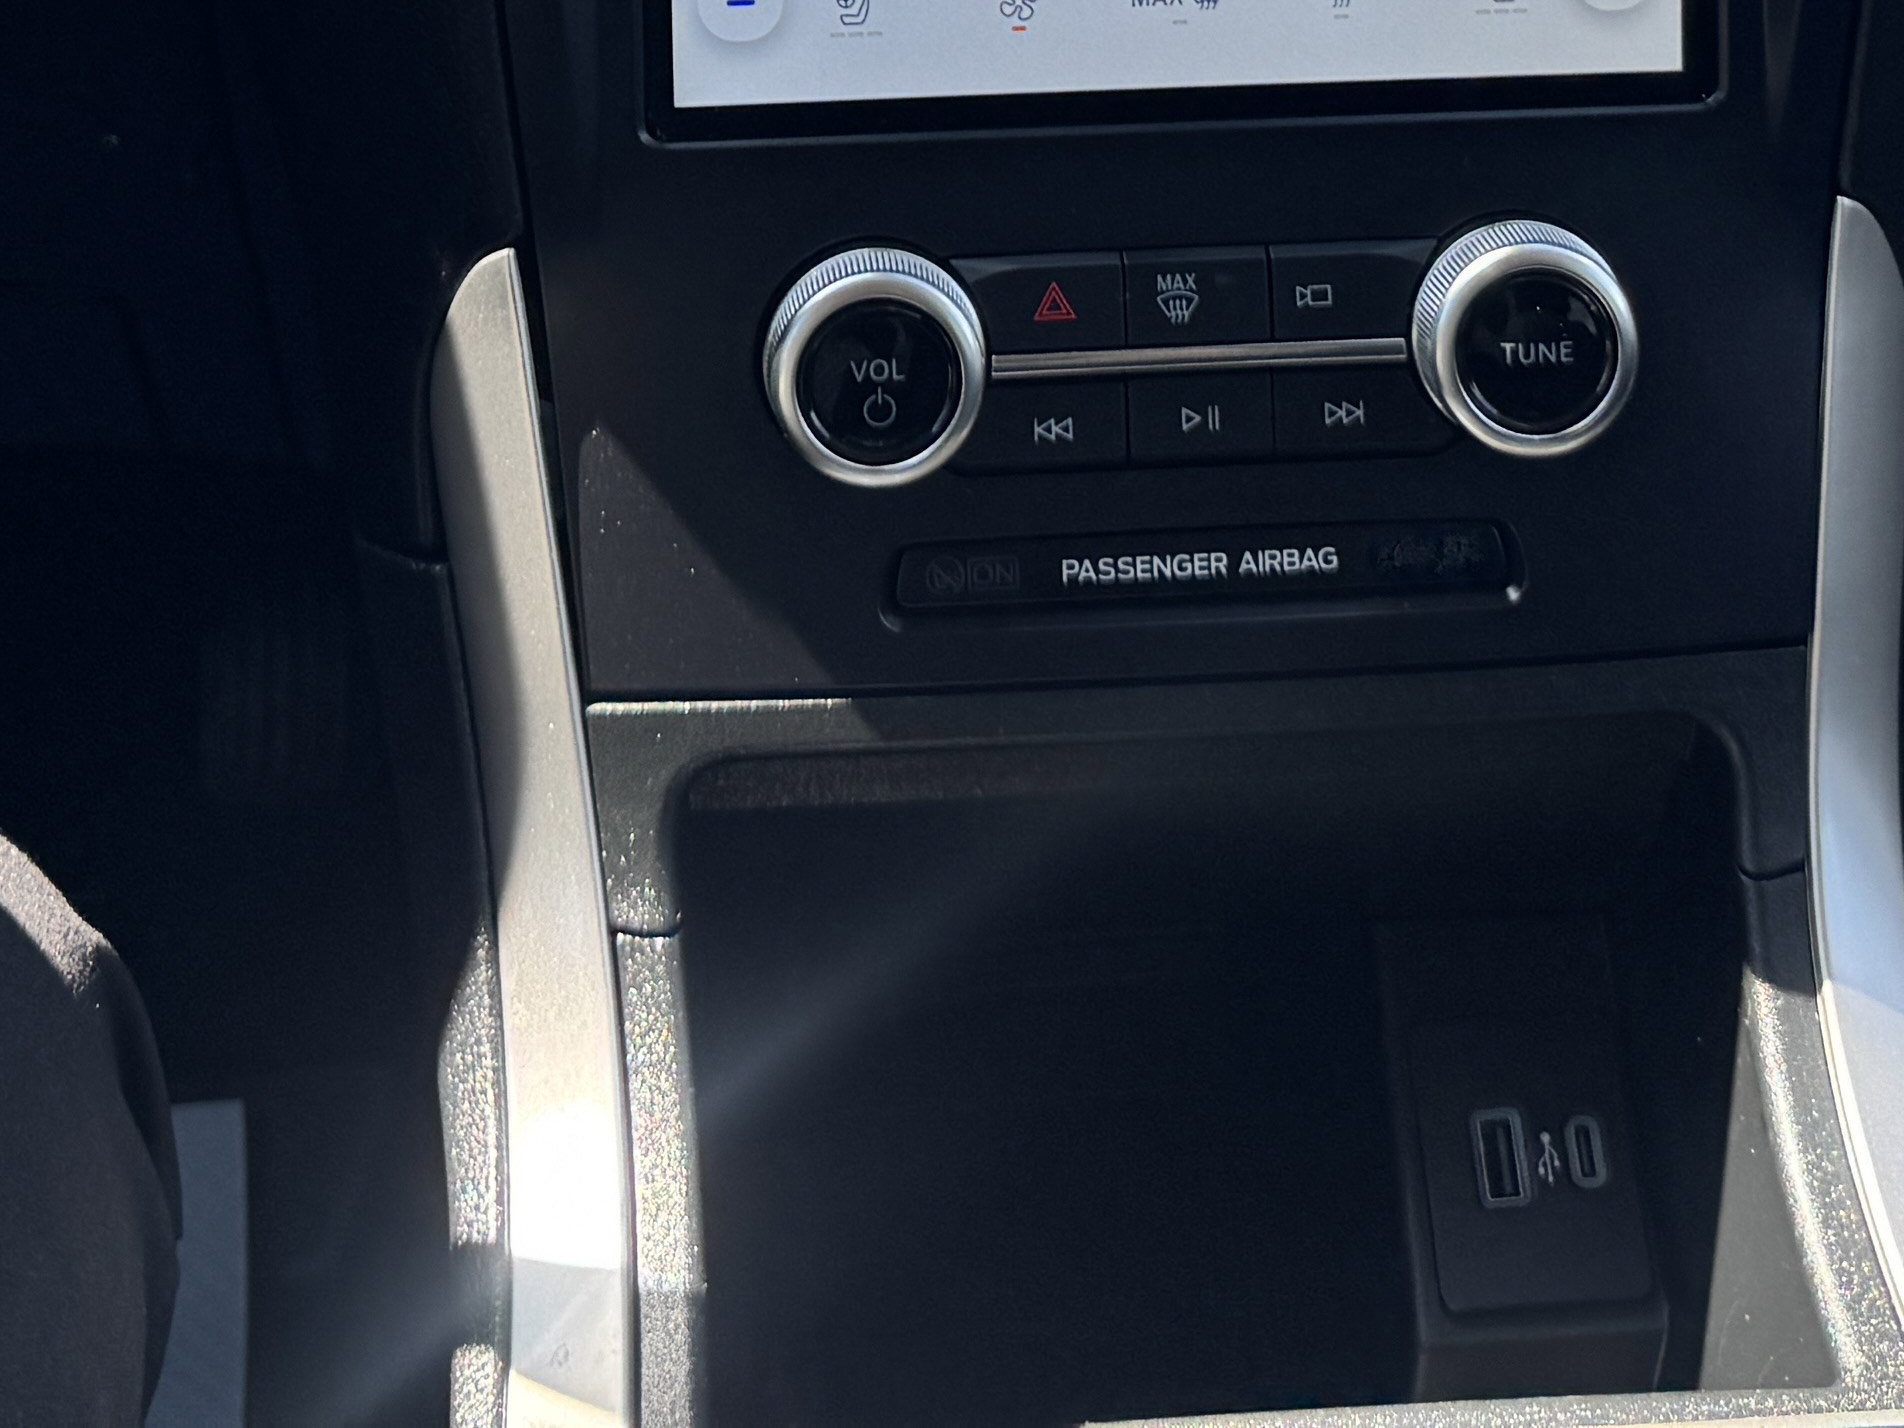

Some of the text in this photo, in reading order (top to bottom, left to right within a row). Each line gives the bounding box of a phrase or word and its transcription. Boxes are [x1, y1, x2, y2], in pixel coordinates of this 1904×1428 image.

[1156, 272, 1197, 293] MAX
[1500, 339, 1575, 368] TUNE
[850, 357, 906, 384] VOL
[1061, 550, 1228, 587] PASSENGER
[1238, 545, 1339, 578] AIRBAG
